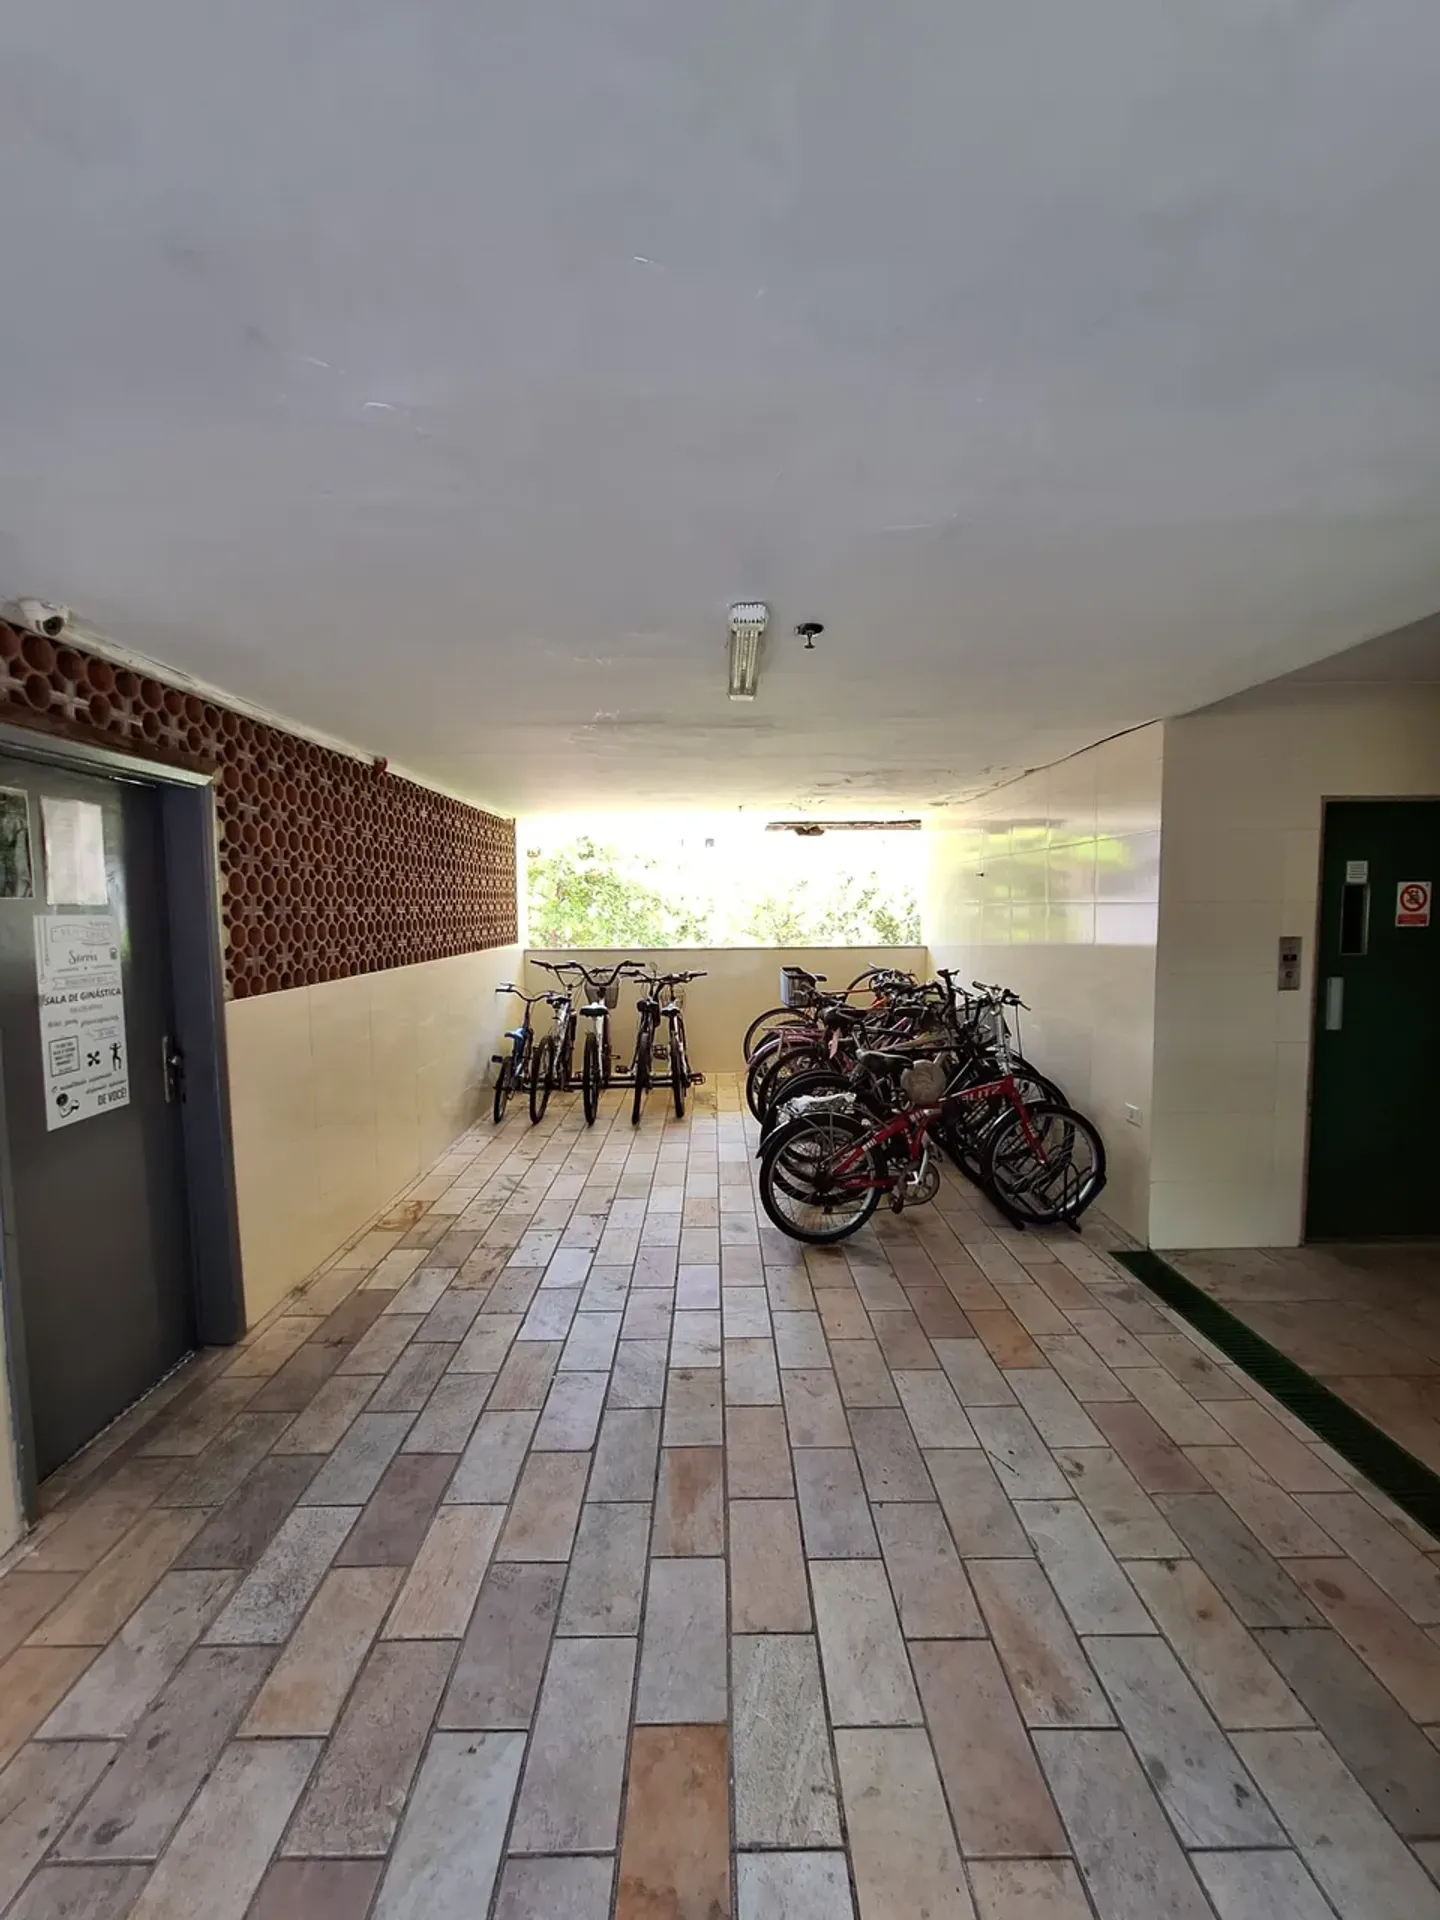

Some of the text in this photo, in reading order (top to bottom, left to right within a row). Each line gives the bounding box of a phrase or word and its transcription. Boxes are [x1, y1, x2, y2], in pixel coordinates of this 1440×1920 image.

[43, 987, 122, 1006] SALA DE GINÁSTICA
[97, 1094, 107, 1106] DE
